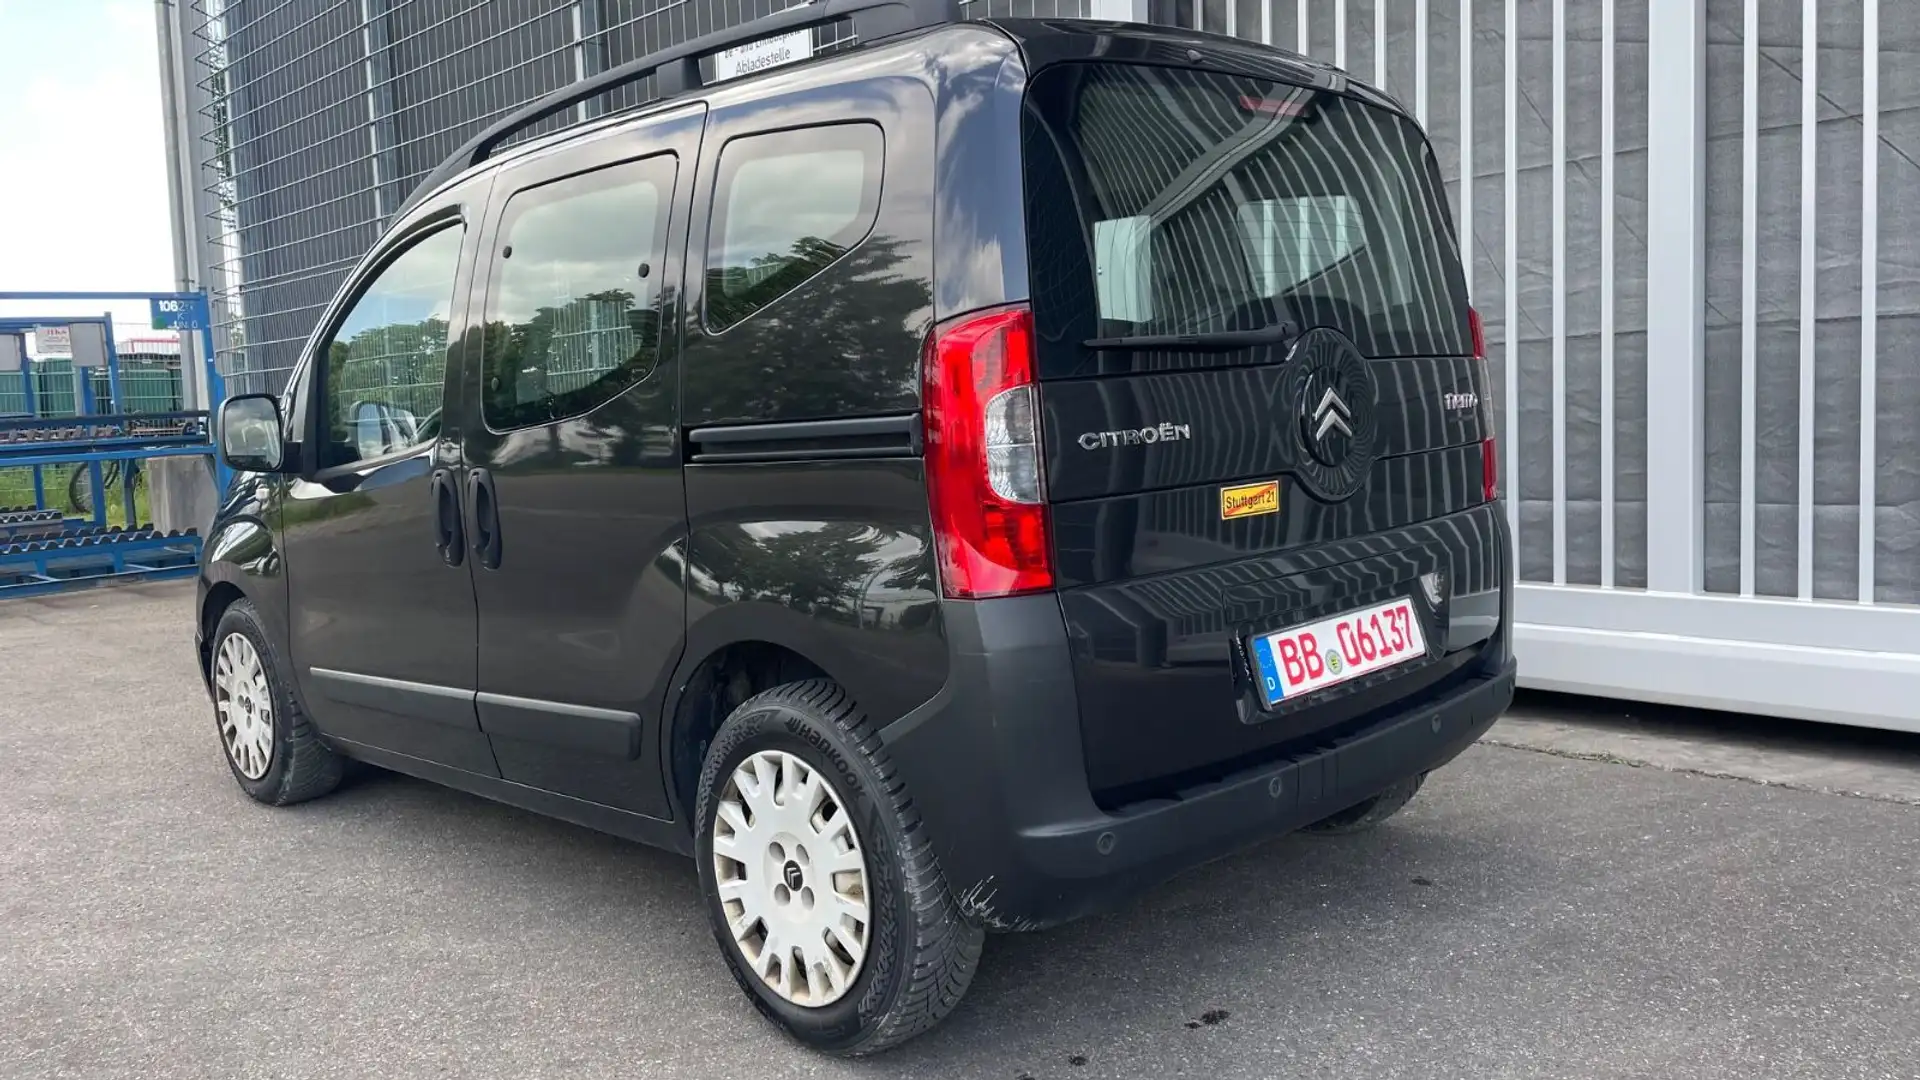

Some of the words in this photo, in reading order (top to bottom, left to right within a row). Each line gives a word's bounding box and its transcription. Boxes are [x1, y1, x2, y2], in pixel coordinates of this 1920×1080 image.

[736, 48, 791, 75] Abladestelle
[1078, 422, 1191, 450] CITROËN
[1266, 490, 1275, 503] 21
[1278, 633, 1325, 687] BB
[1336, 605, 1414, 667] 06137
[1267, 676, 1276, 691] D
